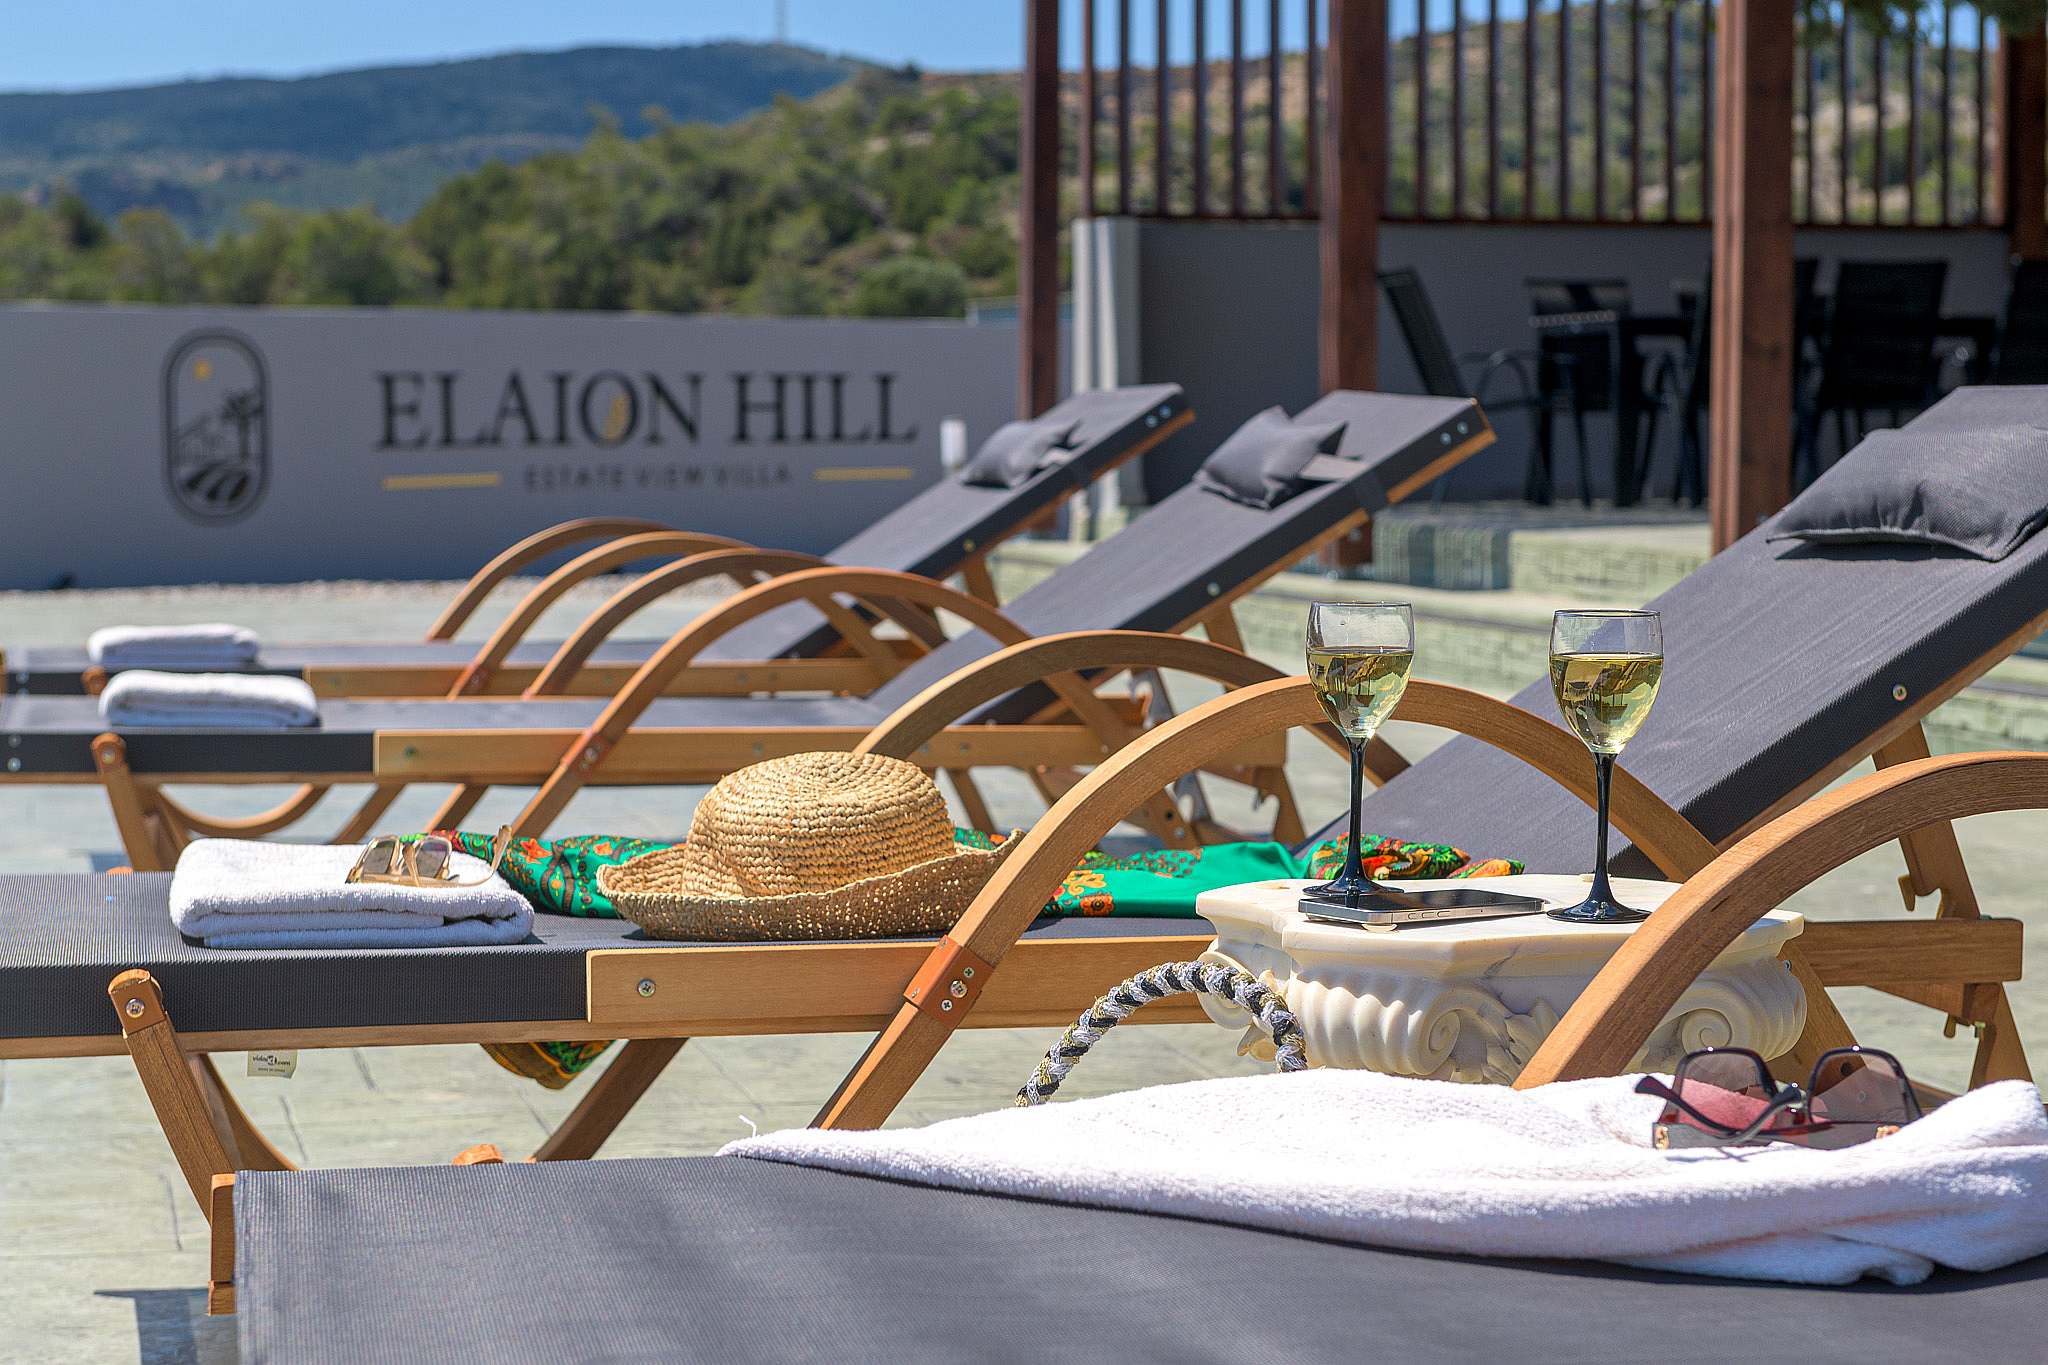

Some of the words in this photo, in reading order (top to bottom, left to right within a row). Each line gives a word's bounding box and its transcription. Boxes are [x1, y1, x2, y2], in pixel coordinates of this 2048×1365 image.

[375, 368, 703, 449] ELAION
[731, 371, 919, 445] HILL
[522, 463, 624, 492] ESTATE
[636, 463, 705, 489] VIEW
[715, 461, 792, 487] VILLA
